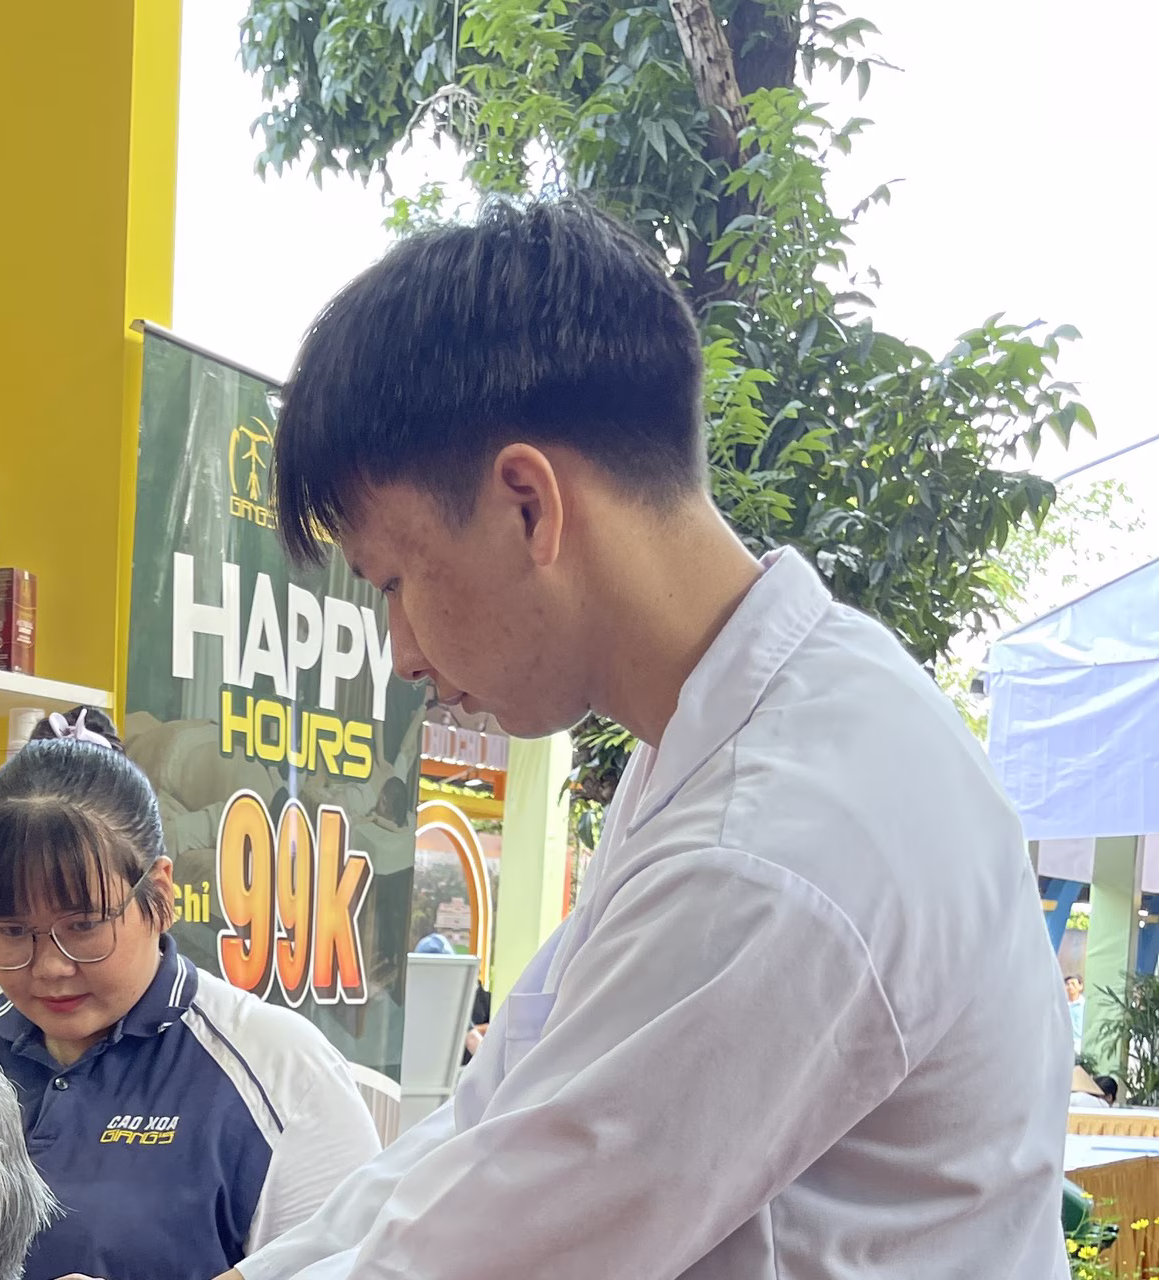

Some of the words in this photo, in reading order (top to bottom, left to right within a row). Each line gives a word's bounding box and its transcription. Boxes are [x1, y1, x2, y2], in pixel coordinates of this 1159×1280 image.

[172, 551, 393, 721] HAPPY
[221, 690, 373, 779] HOURS
[216, 788, 374, 1008] 99k
[107, 1115, 143, 1130] CAO
[144, 1116, 180, 1131] XOA
